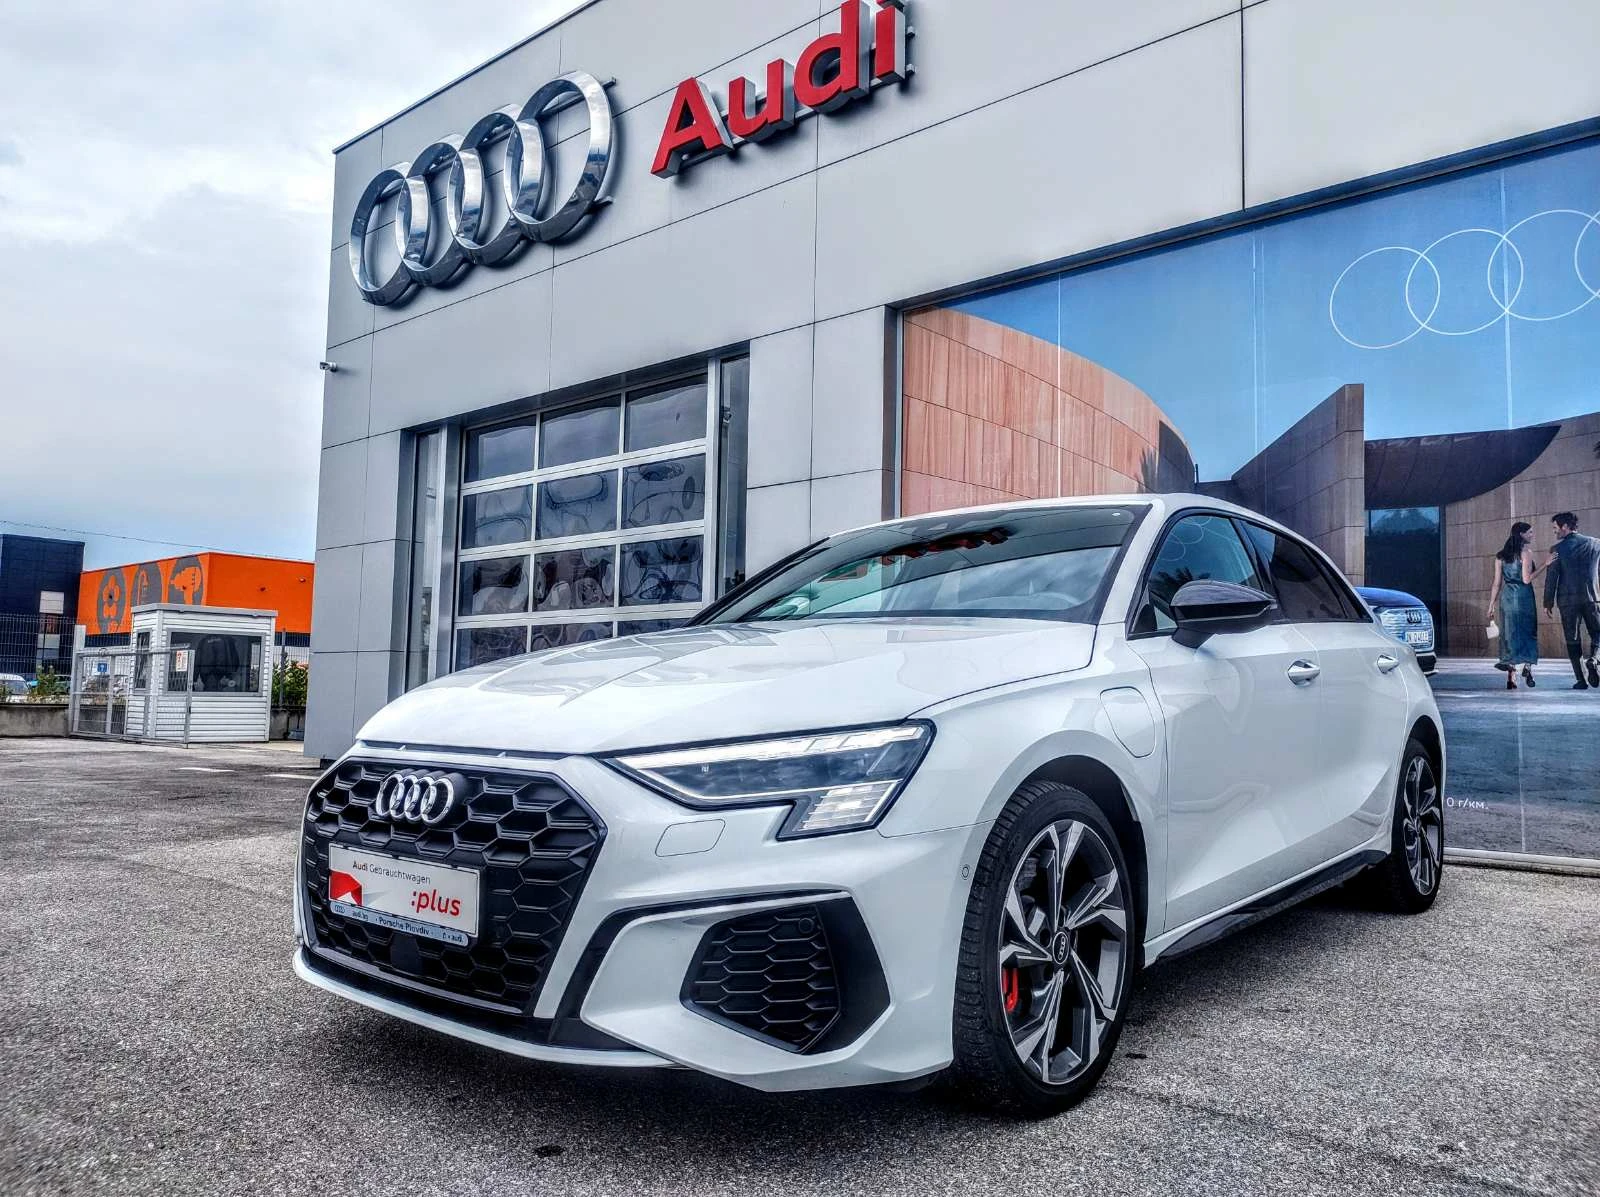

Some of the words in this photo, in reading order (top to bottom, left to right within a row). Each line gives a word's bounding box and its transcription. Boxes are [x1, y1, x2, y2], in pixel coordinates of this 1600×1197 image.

[650, 0, 902, 177] Audi
[1446, 797, 1455, 807] 0
[352, 860, 368, 873] Audi
[369, 864, 431, 885] Gebrauchtwagen
[410, 889, 462, 917] :plus
[405, 922, 430, 936] Plovdiv
